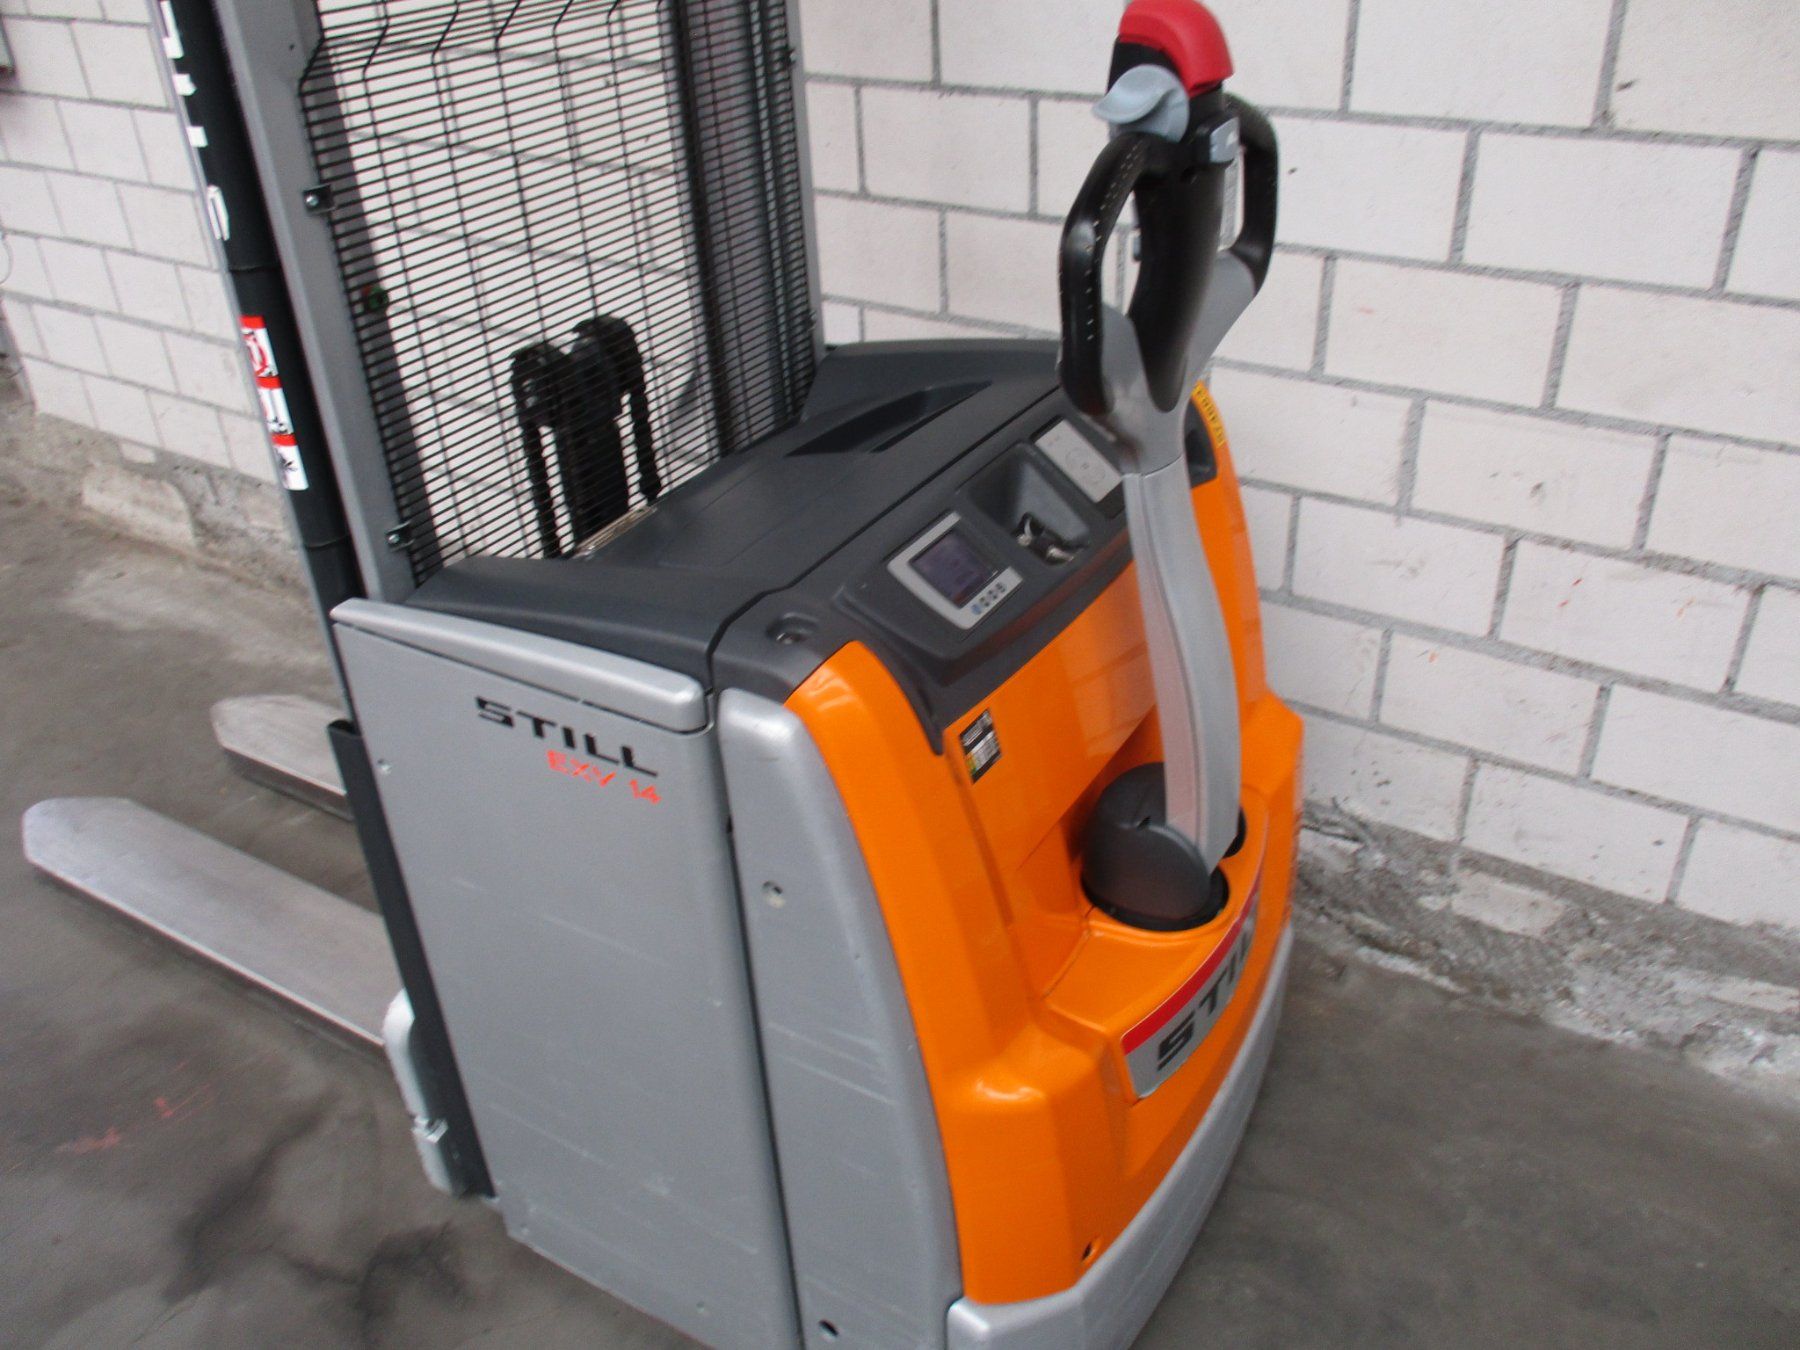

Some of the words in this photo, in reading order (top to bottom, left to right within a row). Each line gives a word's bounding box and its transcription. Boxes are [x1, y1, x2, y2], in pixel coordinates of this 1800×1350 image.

[476, 697, 659, 777] STILL
[547, 749, 616, 787] EXV
[630, 779, 662, 803] 14
